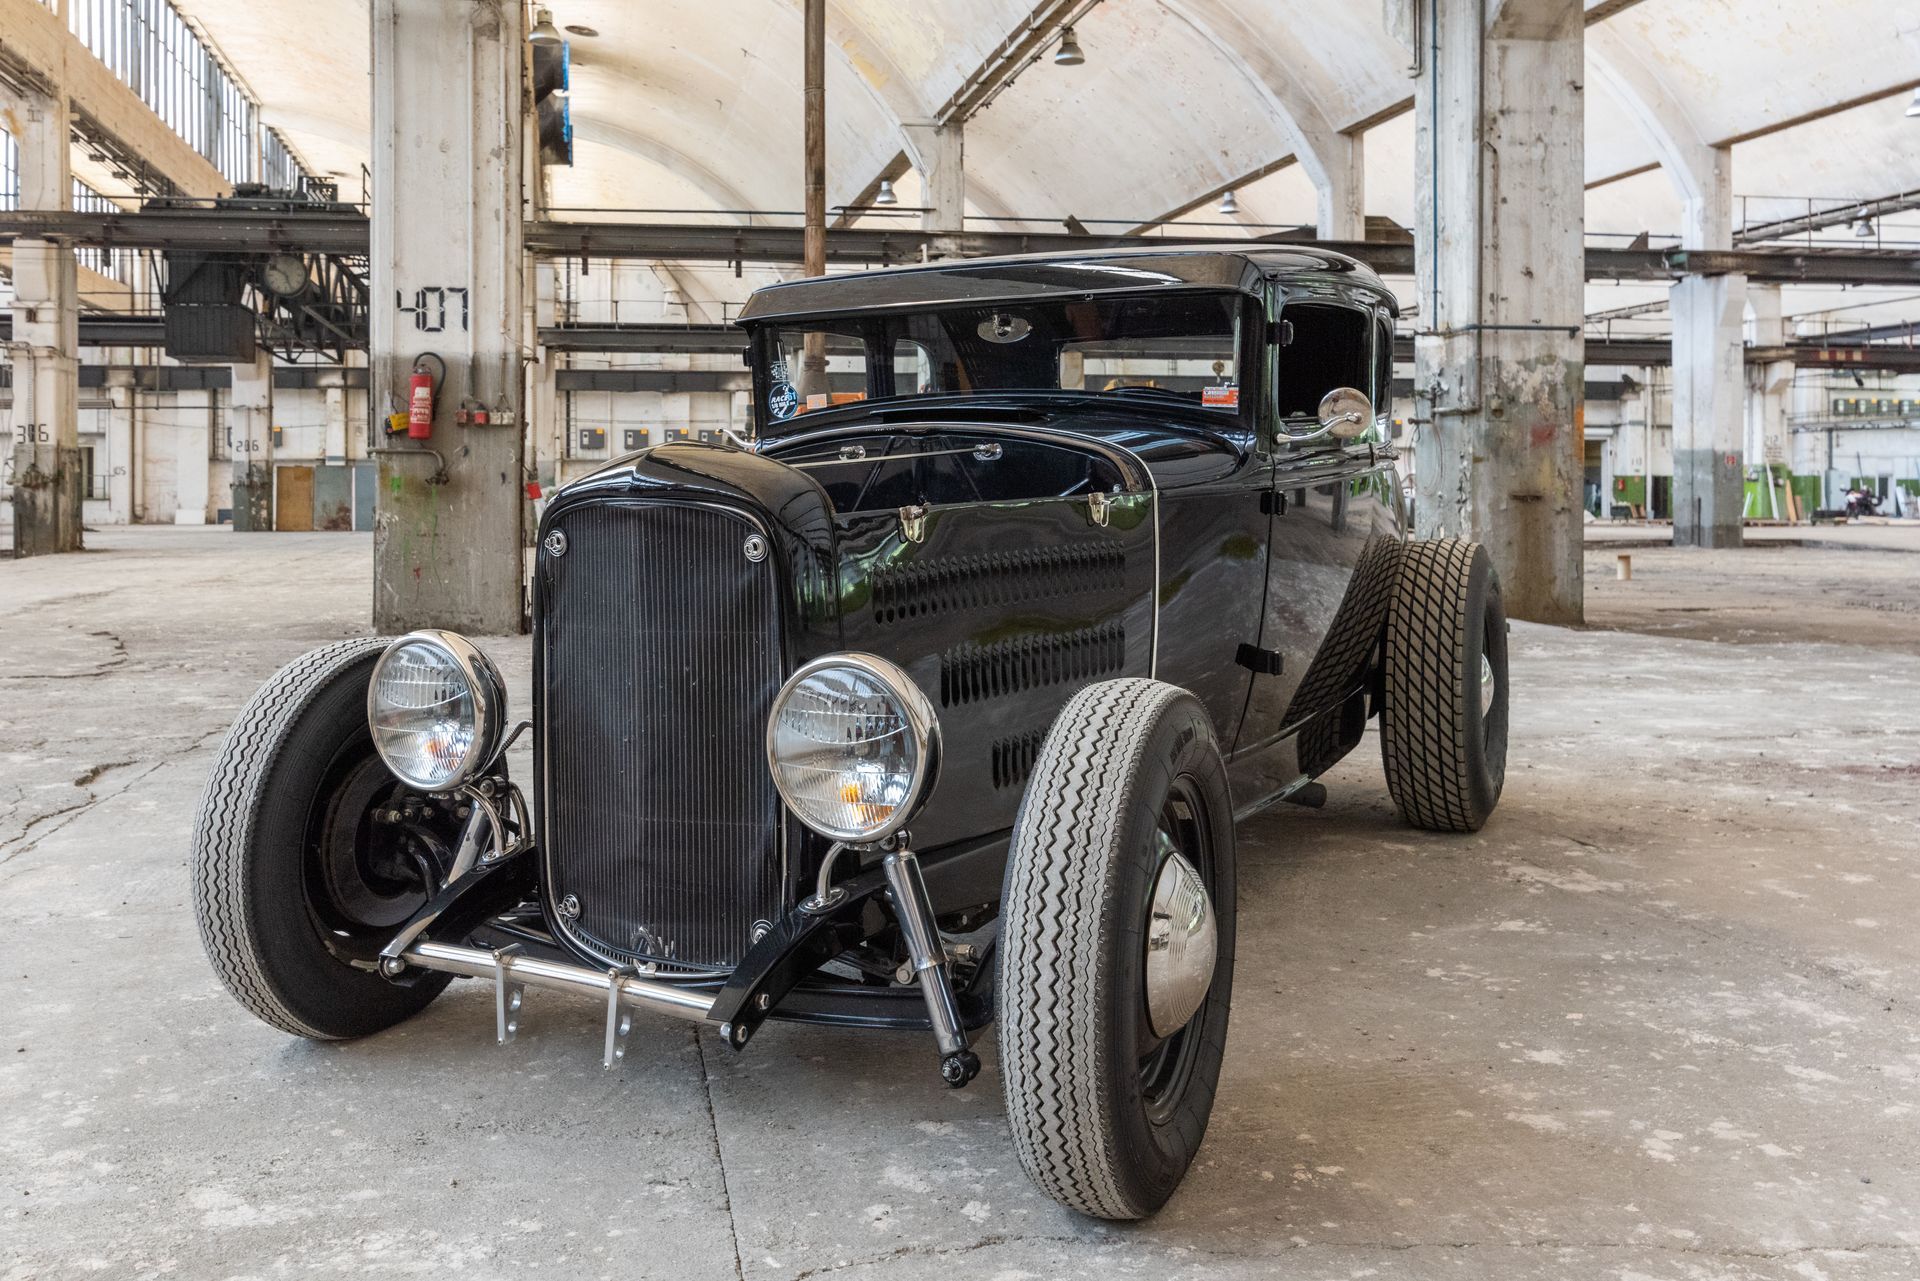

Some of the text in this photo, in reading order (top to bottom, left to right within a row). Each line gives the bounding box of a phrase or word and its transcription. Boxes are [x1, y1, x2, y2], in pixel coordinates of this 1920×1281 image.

[397, 287, 468, 332] 407
[17, 424, 49, 444] 306
[236, 440, 259, 452] 206
